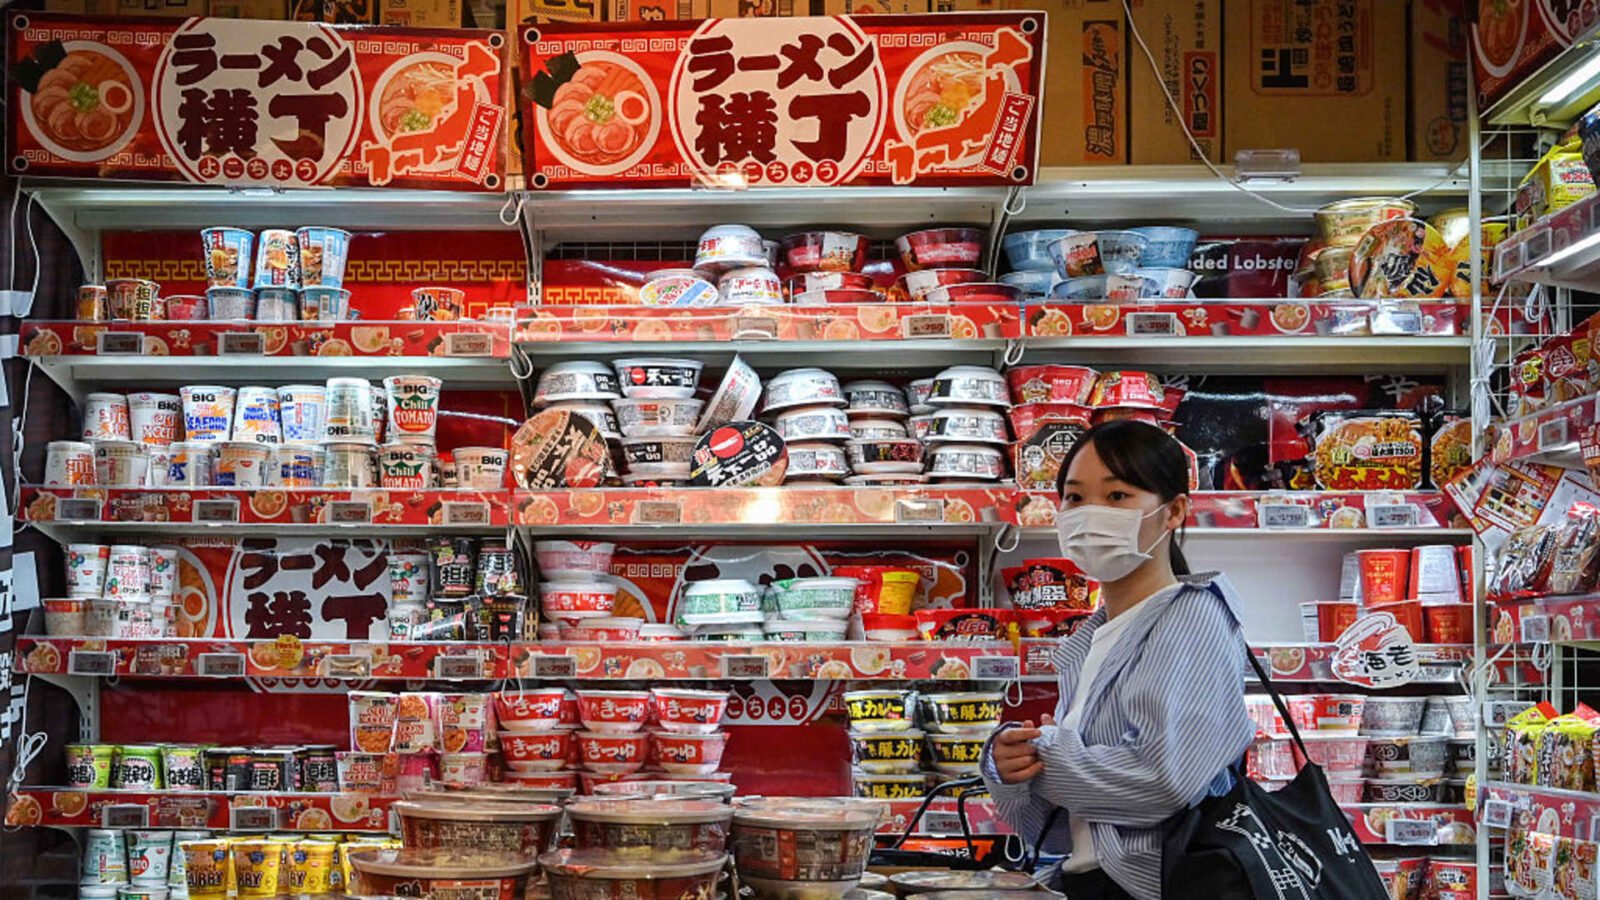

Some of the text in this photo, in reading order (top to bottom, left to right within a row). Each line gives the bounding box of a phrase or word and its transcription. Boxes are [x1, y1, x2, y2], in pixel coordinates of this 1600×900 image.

[172, 33, 351, 90] ラーメン
[688, 32, 875, 92] ラーメン
[177, 88, 349, 162] 横丁
[695, 90, 871, 166] 横丁
[202, 159, 316, 178] よこちょう
[647, 368, 695, 386] 天下一品
[192, 393, 215, 402] BIG
[403, 385, 427, 394] BIG
[158, 401, 180, 411] BIG
[400, 400, 429, 410] Chili
[185, 415, 227, 431] SEAFOOD
[394, 410, 435, 425] TOMATO
[390, 451, 413, 461] BIG
[481, 456, 502, 465] BIG
[708, 440, 778, 486] 天下一品
[387, 466, 416, 476] Chili
[384, 477, 423, 488] TOMATO
[240, 536, 390, 591] ラーメン
[245, 591, 388, 640] 横丁
[1359, 645, 1412, 674] 海老
[1371, 668, 1415, 684] ラーメン
[727, 698, 806, 719] こちょう
